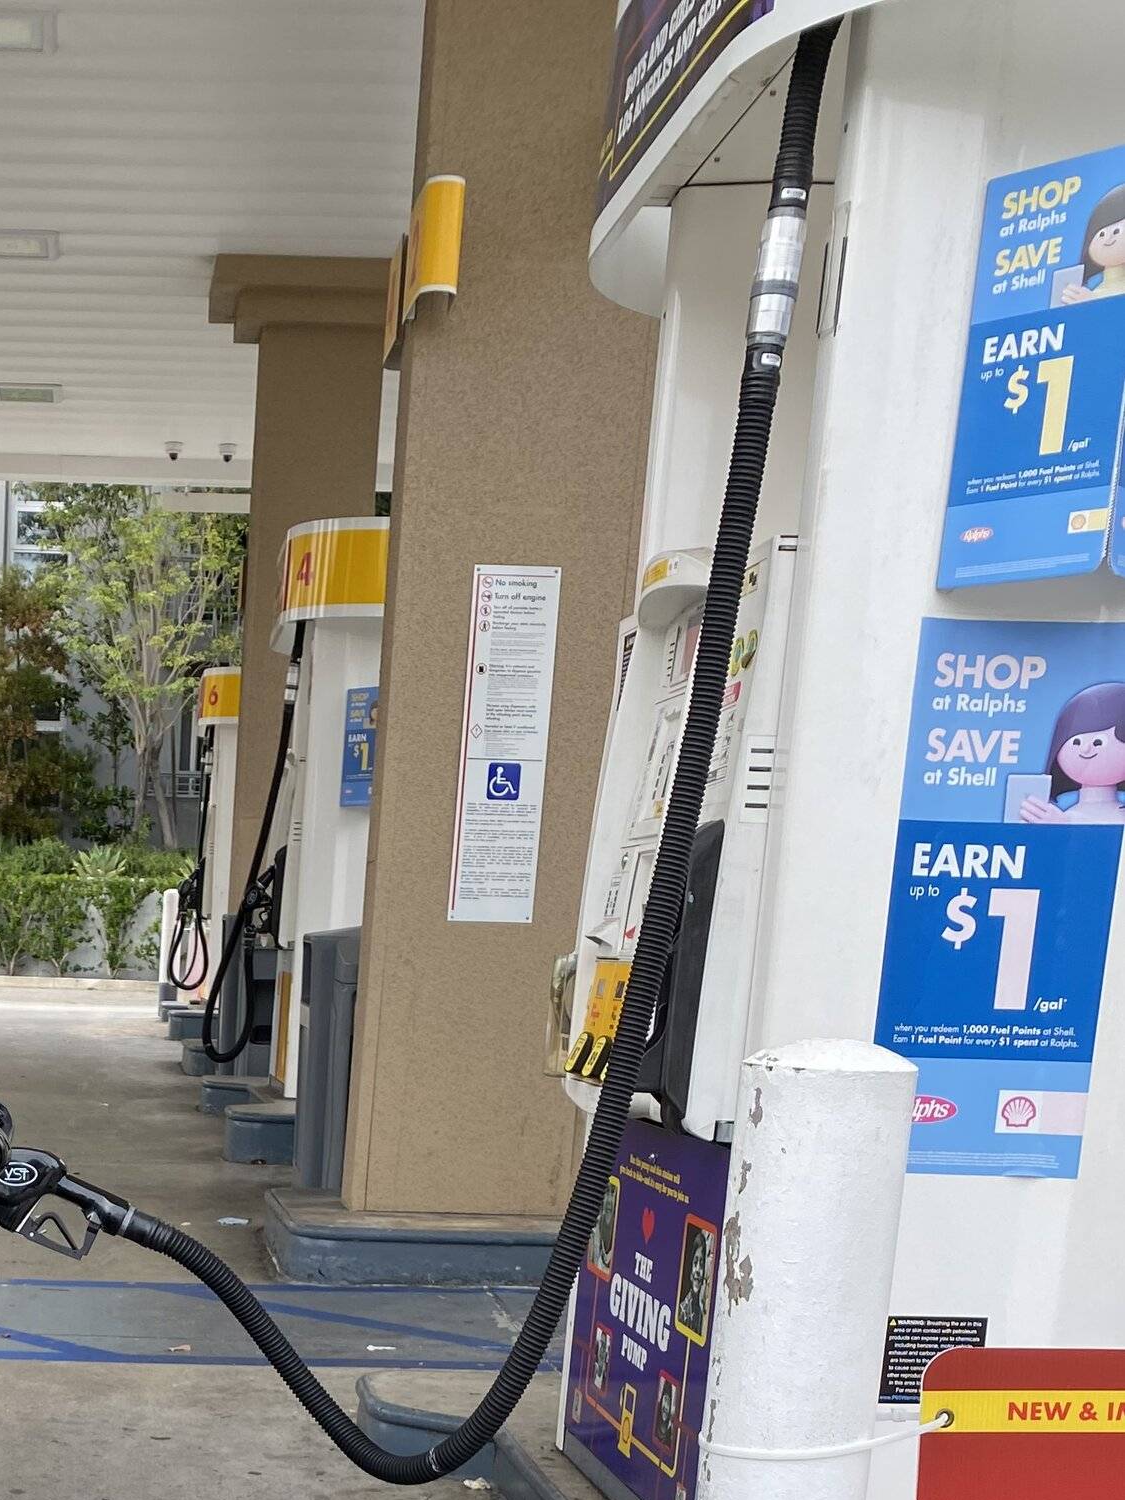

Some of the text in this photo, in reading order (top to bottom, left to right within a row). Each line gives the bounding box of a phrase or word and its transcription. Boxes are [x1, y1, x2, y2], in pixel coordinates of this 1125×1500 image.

[1001, 176, 1082, 219] SHOP
[999, 210, 1067, 237] at Ralphs
[994, 237, 1063, 276] SAVE
[992, 268, 1046, 295] at Shell
[982, 322, 1065, 365] EARN
[980, 371, 993, 383] up
[994, 367, 1004, 378] to
[296, 552, 313, 587] 4
[495, 578, 537, 588] No smoking
[495, 592, 546, 602] Turn off engine
[934, 652, 1047, 690] SHOP
[209, 685, 219, 706] 6
[932, 692, 1027, 718] at Ralphs
[925, 727, 1022, 764] SAVE
[923, 766, 997, 787] at Shell
[912, 843, 1026, 879] EARN
[909, 885, 924, 900] up
[927, 884, 940, 897] to
[893, 1034, 908, 1043] Earn
[910, 1034, 915, 1043] 1
[918, 1035, 937, 1044] Fuel
[939, 1035, 962, 1044] Point
[963, 1035, 974, 1044] for
[975, 1038, 997, 1048] every
[999, 1036, 1010, 1046] $1
[1013, 1038, 1039, 1048] spent
[1040, 1039, 1048, 1047] at
[894, 1022, 913, 1032] when
[915, 1025, 929, 1034] you
[930, 1024, 959, 1033] redeem
[963, 1024, 989, 1034] 1,000
[991, 1025, 1010, 1034] Fuel
[1012, 1025, 1041, 1035] Points
[1043, 1028, 1052, 1036] at
[912, 1096, 952, 1121] lphs
[635, 1251, 653, 1283] THE
[609, 1272, 672, 1352] GIVING
[621, 1333, 647, 1372] PUMP
[1007, 1402, 1072, 1421] NEW
[1079, 1402, 1098, 1421] &
